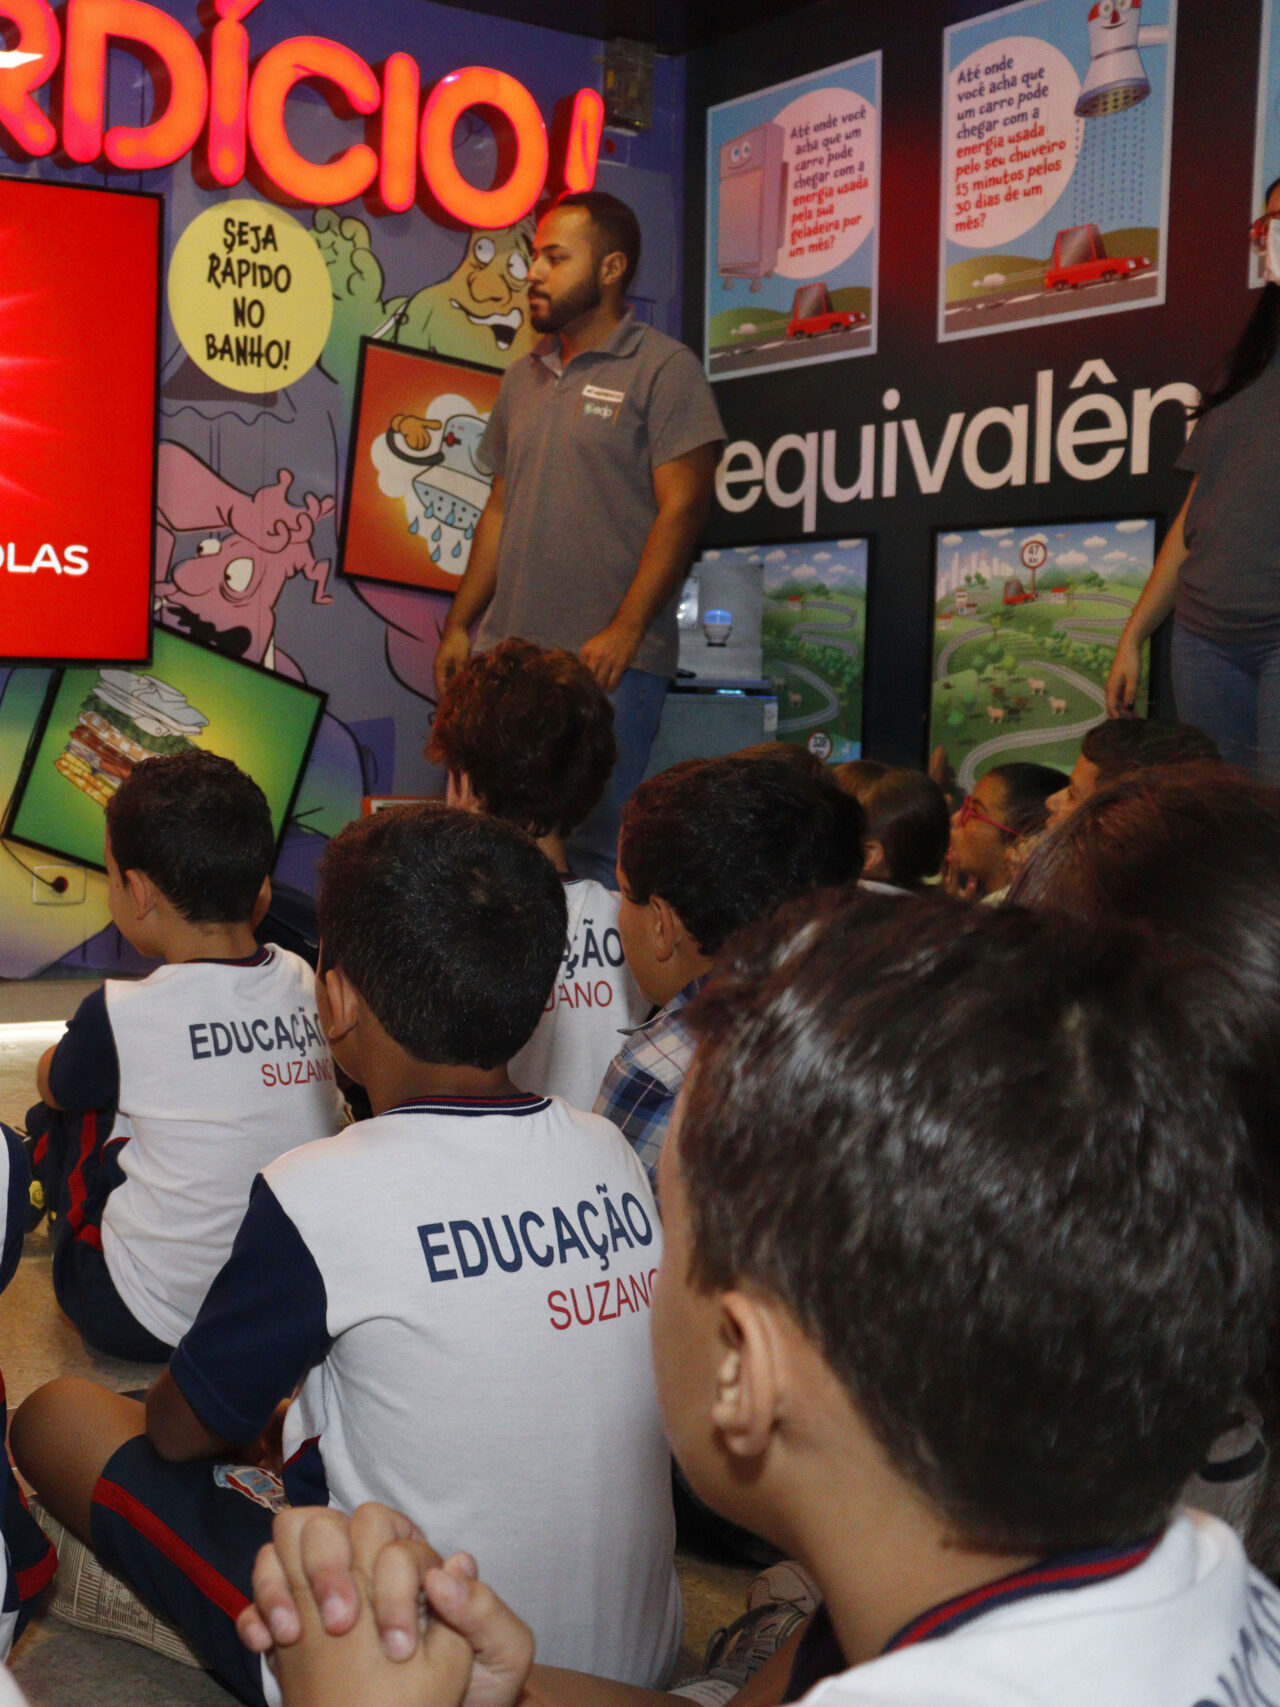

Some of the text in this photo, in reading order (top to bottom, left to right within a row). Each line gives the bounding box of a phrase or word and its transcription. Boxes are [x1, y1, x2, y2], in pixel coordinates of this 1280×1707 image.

[957, 55, 1013, 84] Até onde
[957, 67, 1045, 102] você acha que
[957, 84, 1048, 120] um carro pode
[790, 105, 866, 139] Até onde você
[957, 107, 1039, 140] chegar com a
[795, 127, 862, 155] acha que um
[956, 121, 1045, 158] energia usada
[794, 161, 865, 189] chegar com a
[795, 146, 853, 172] carro pode
[955, 139, 1066, 181] pelo seu chuveiro
[793, 174, 869, 206] energia usada
[956, 158, 1062, 196] 15 minutos pelos
[955, 184, 1042, 215] 30 dias de um
[790, 214, 862, 245] geladeira por
[791, 204, 834, 229] pela sua
[955, 212, 986, 232] mês?
[223, 218, 278, 254] SEJA
[789, 235, 836, 257] um mês?
[207, 250, 292, 294] RÁPIDO
[233, 296, 265, 328] NO
[205, 333, 291, 370] BANHO!
[417, 1183, 652, 1282] EDUCAÇÃO
